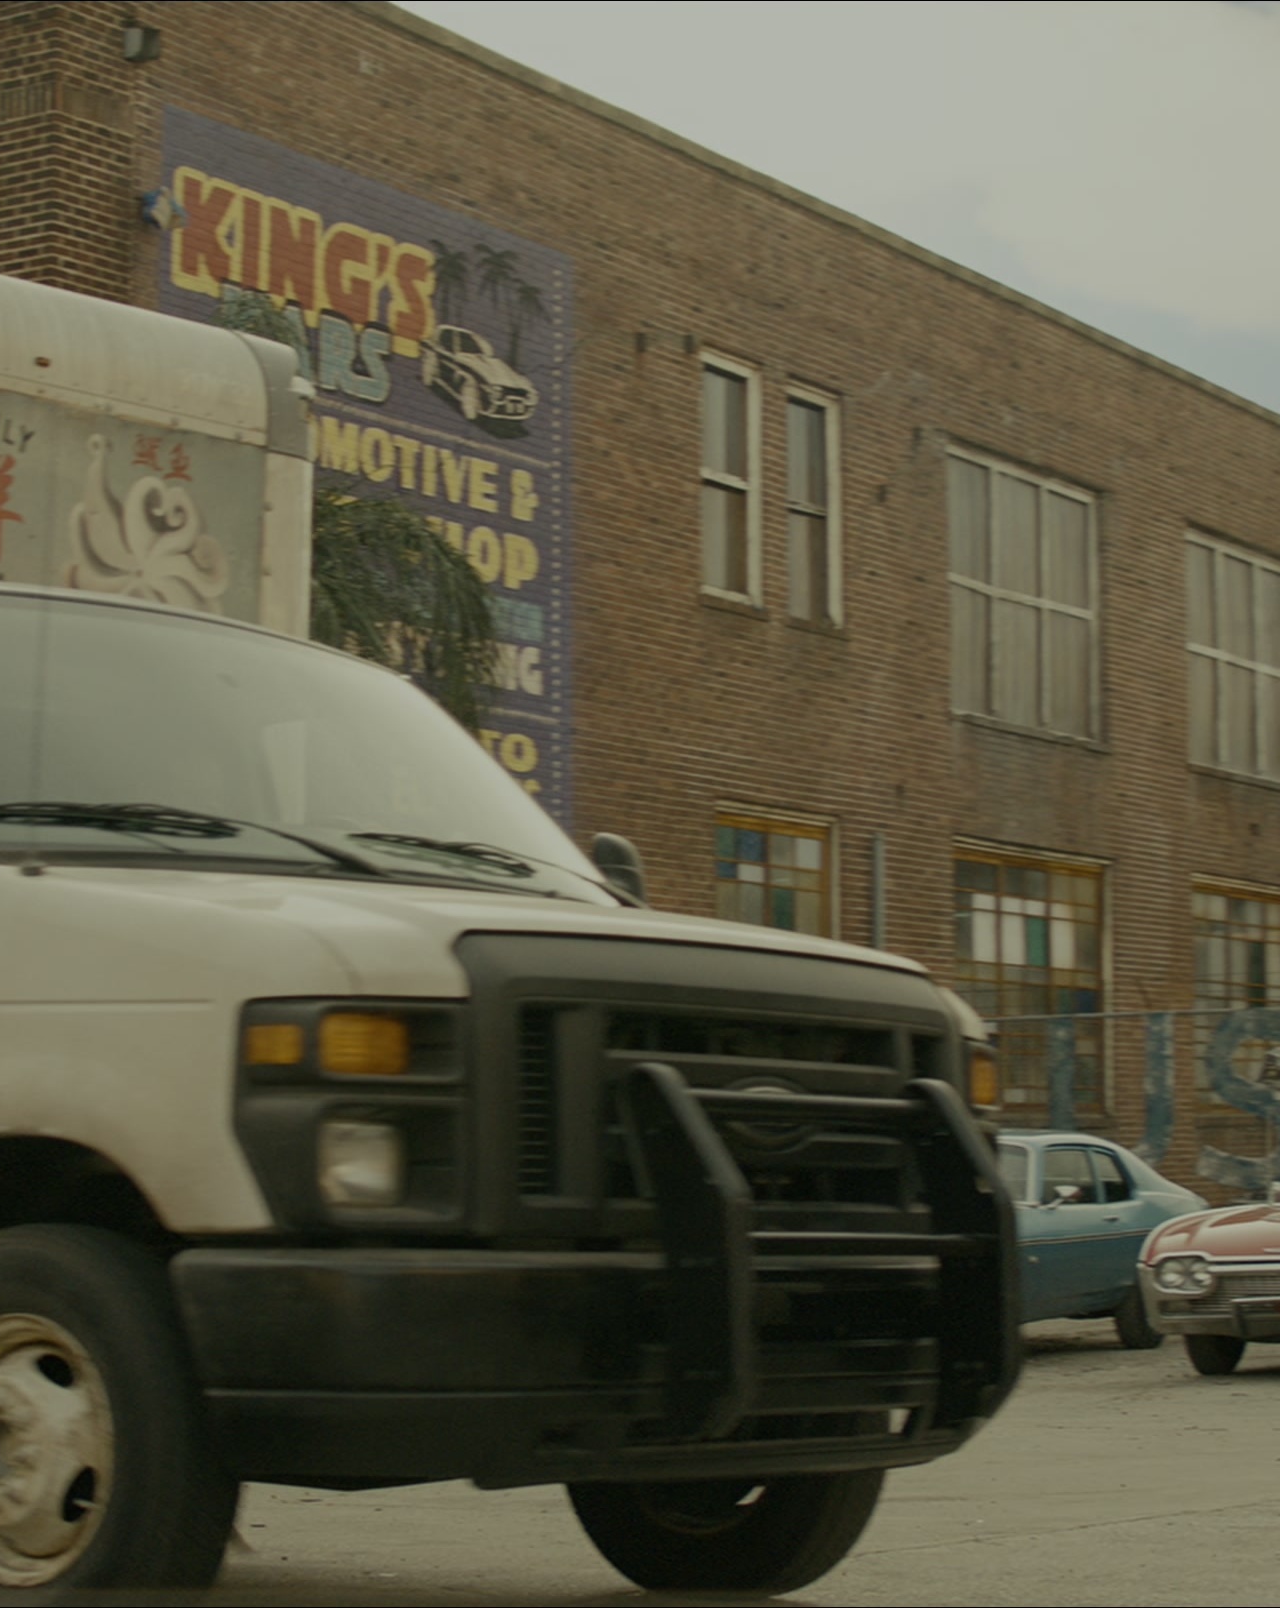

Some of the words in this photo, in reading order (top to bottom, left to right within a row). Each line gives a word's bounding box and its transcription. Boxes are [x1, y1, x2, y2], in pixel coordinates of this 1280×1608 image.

[171, 165, 437, 359] KING'S
[308, 415, 500, 514] MOTIVE
[510, 468, 540, 522] &
[425, 514, 541, 591] OP
[479, 728, 540, 774] TO
